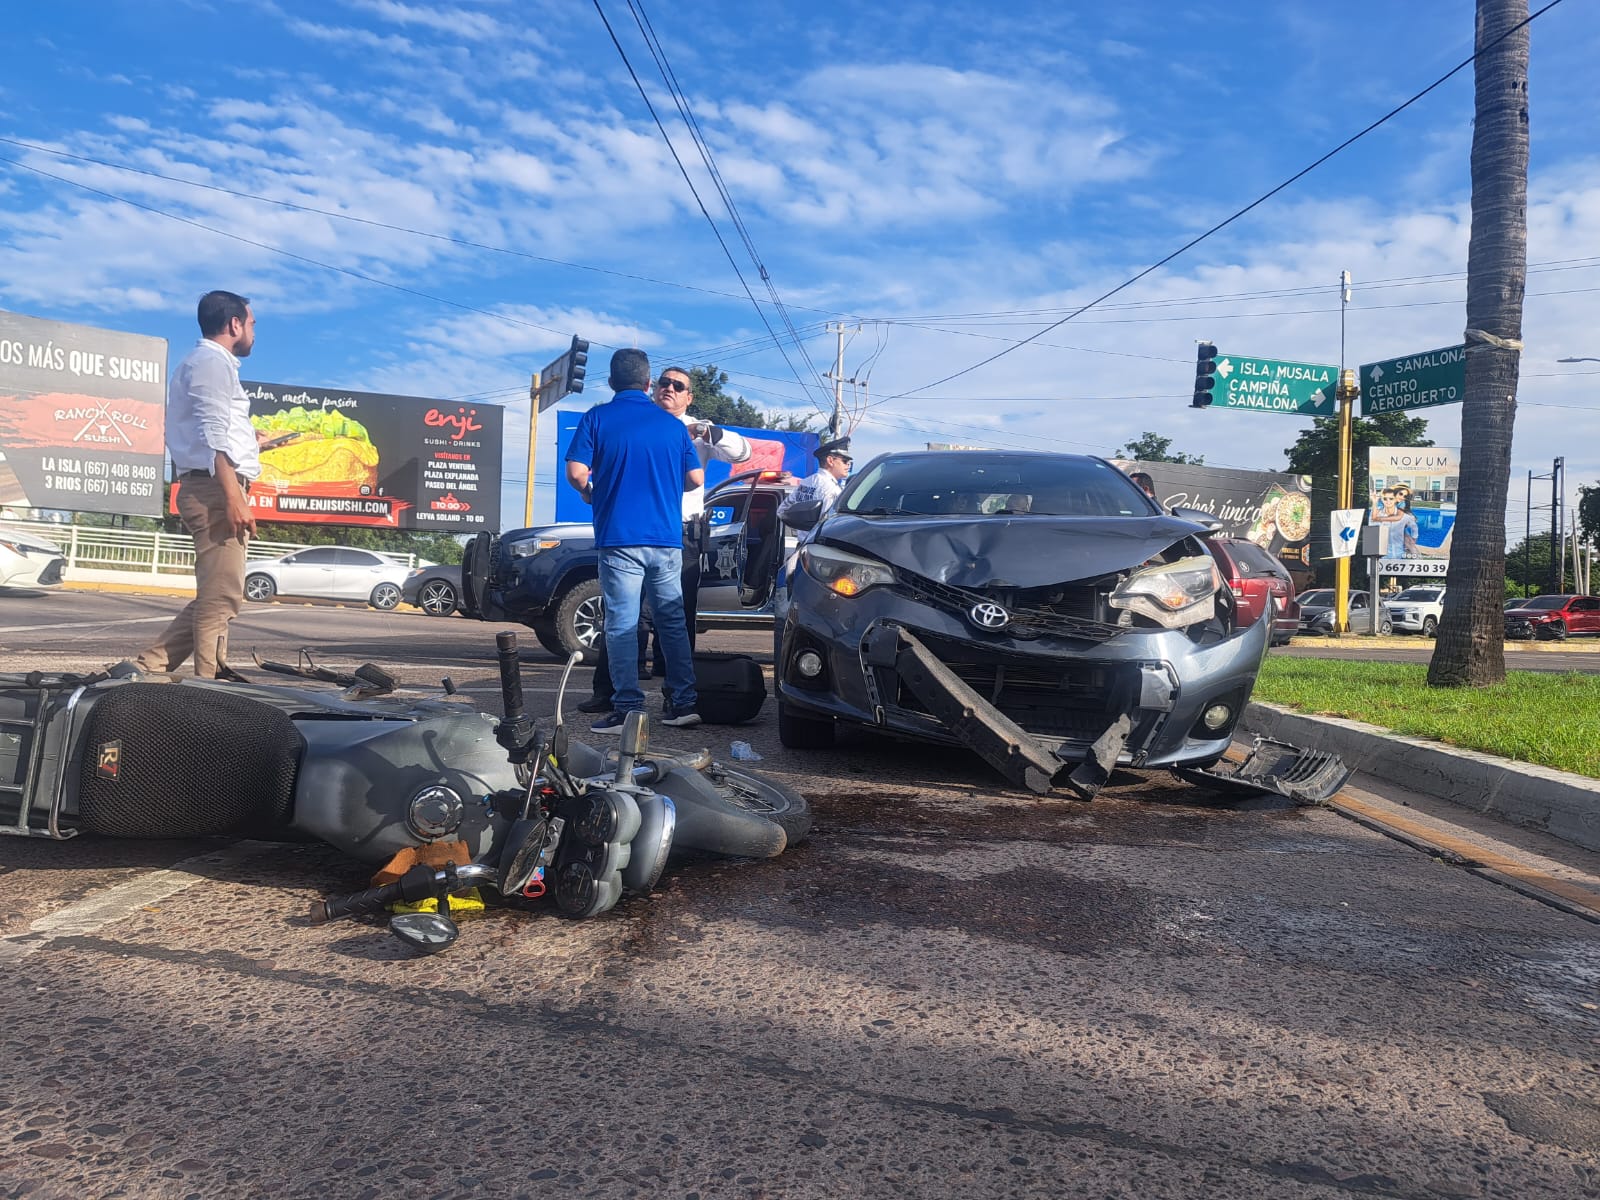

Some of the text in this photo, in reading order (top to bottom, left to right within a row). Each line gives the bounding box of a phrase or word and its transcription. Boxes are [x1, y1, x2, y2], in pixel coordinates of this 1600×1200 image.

[28, 341, 65, 371] MÁS
[69, 350, 104, 376] QUE
[109, 356, 160, 384] SUSHI
[1395, 348, 1466, 373] SANALONA
[1240, 362, 1329, 383] ISLA MUSALA
[1229, 379, 1289, 396] CAMPIÑA
[1369, 378, 1417, 398] CENTRO
[321, 396, 358, 412] pasión
[1228, 393, 1298, 411] SANALONA
[1369, 386, 1457, 412] AEROPUERTO
[111, 410, 149, 430] ROLL
[424, 407, 482, 439] enji
[84, 433, 120, 444] SUSHI
[424, 438, 481, 448] SUSHI DRINKS
[42, 457, 157, 480] LA ISLA (667) 408 8408
[427, 460, 476, 471] PLAZA VENTURA
[1390, 456, 1447, 466] NOVUM
[424, 470, 479, 481] PLAZA EXPLANADA
[45, 475, 154, 497] 3 RIOS (667) 146 6567
[425, 480, 477, 491] PASEO DEL ÁNGEL
[260, 495, 273, 508] EN
[279, 497, 388, 514] WWW.ENJISUSHI.COM
[436, 502, 460, 511] TO GO
[1219, 498, 1262, 523] único
[416, 512, 435, 521] LEYVA
[436, 513, 461, 522] SOLANO
[475, 515, 485, 523] GO
[1385, 563, 1446, 573] 667 730 39
